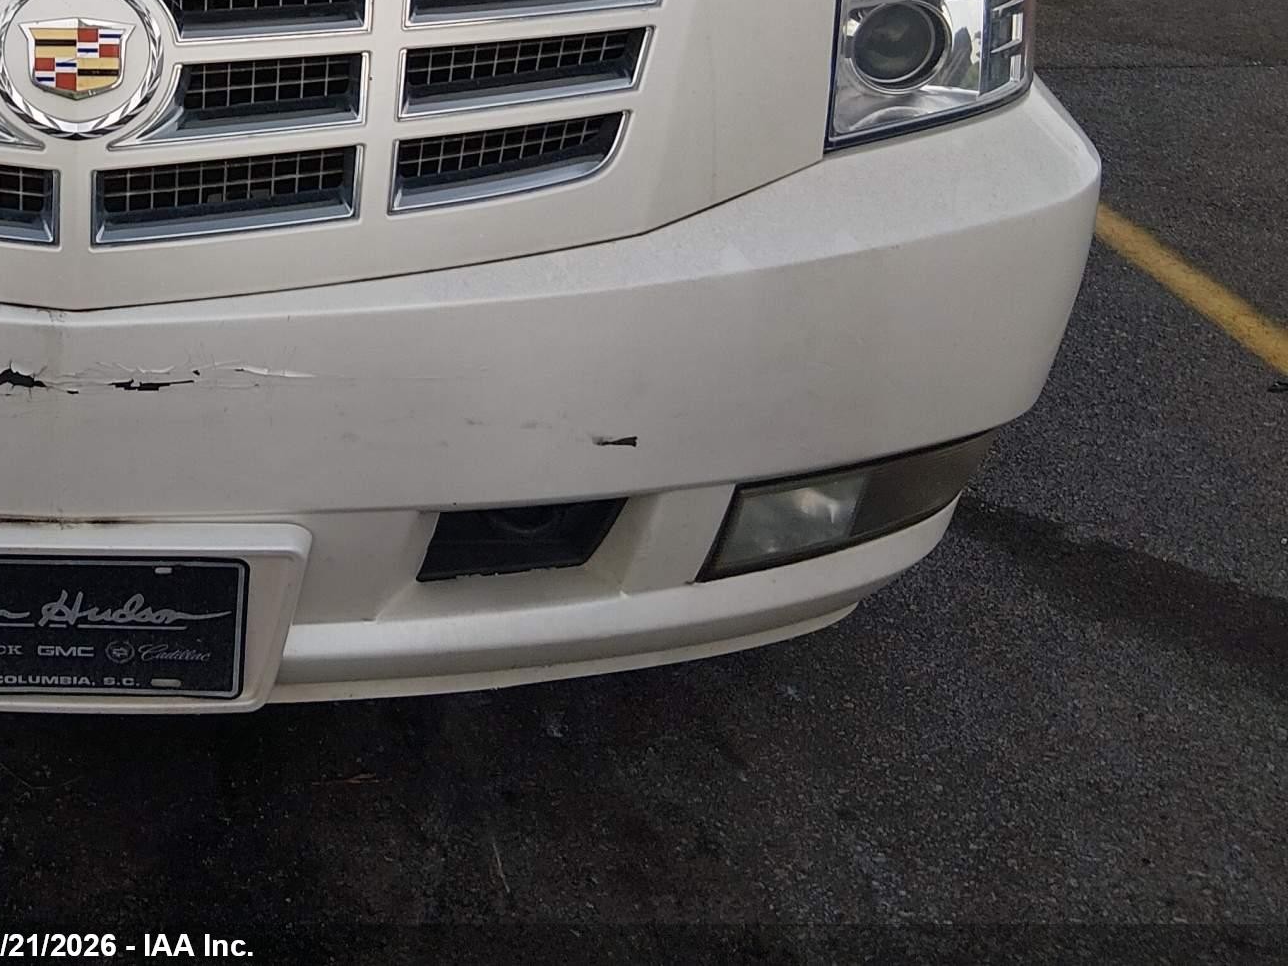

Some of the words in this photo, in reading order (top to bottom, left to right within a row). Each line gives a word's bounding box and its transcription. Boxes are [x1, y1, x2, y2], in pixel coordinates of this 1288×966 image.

[37, 590, 232, 627] Hudson
[37, 644, 94, 657] GMC
[137, 643, 211, 662] Cadillac
[103, 677, 140, 687] S.C.
